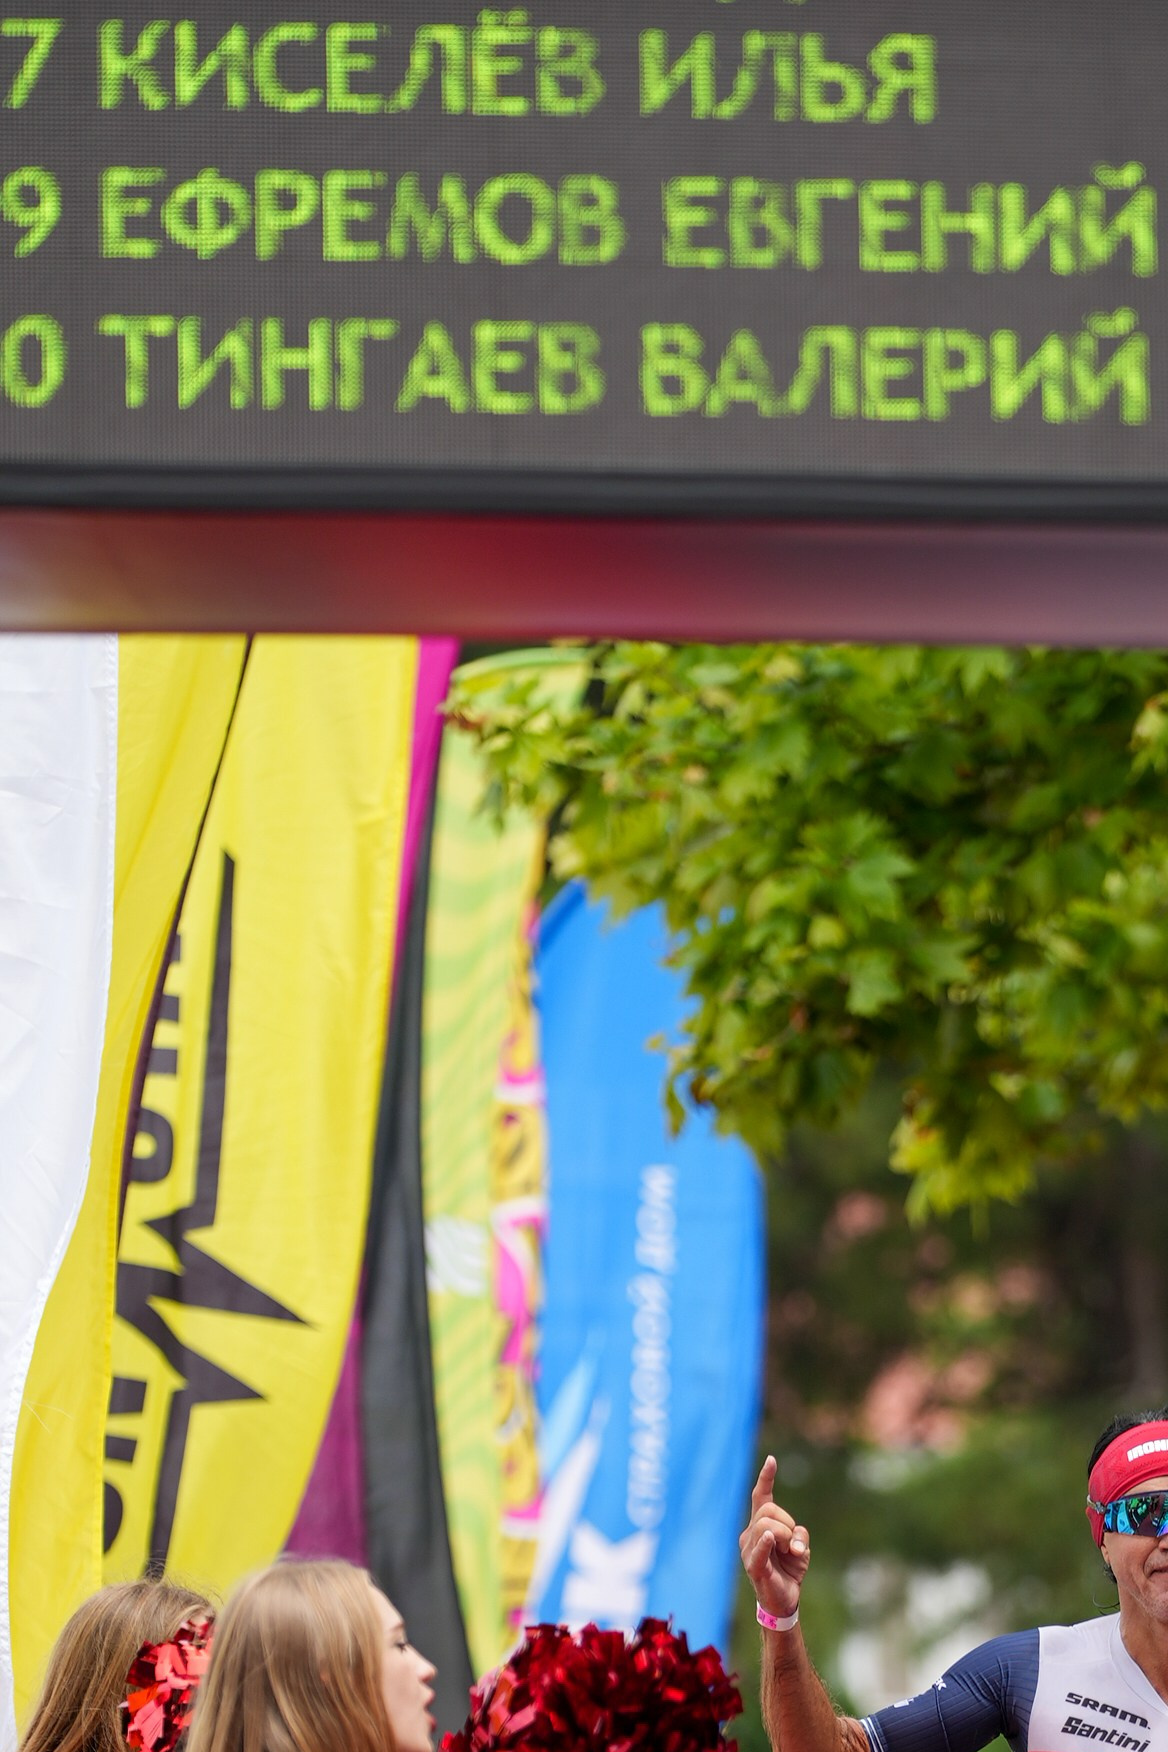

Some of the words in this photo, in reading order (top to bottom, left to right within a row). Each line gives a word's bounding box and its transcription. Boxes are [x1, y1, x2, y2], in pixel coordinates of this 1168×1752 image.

[3, 17, 62, 110] 7
[98, 8, 606, 118] КИСЕЛЁВ
[638, 28, 939, 124] ИЛЬЯ
[0, 166, 63, 259] 9
[98, 166, 626, 266] ЕФРЕМОВ
[662, 160, 1160, 278] ЕВГЕНИЙ
[0, 310, 65, 408] 0
[97, 312, 606, 415] ТИНГАЕВ
[639, 306, 1152, 425] ВАЛЕРИЙ
